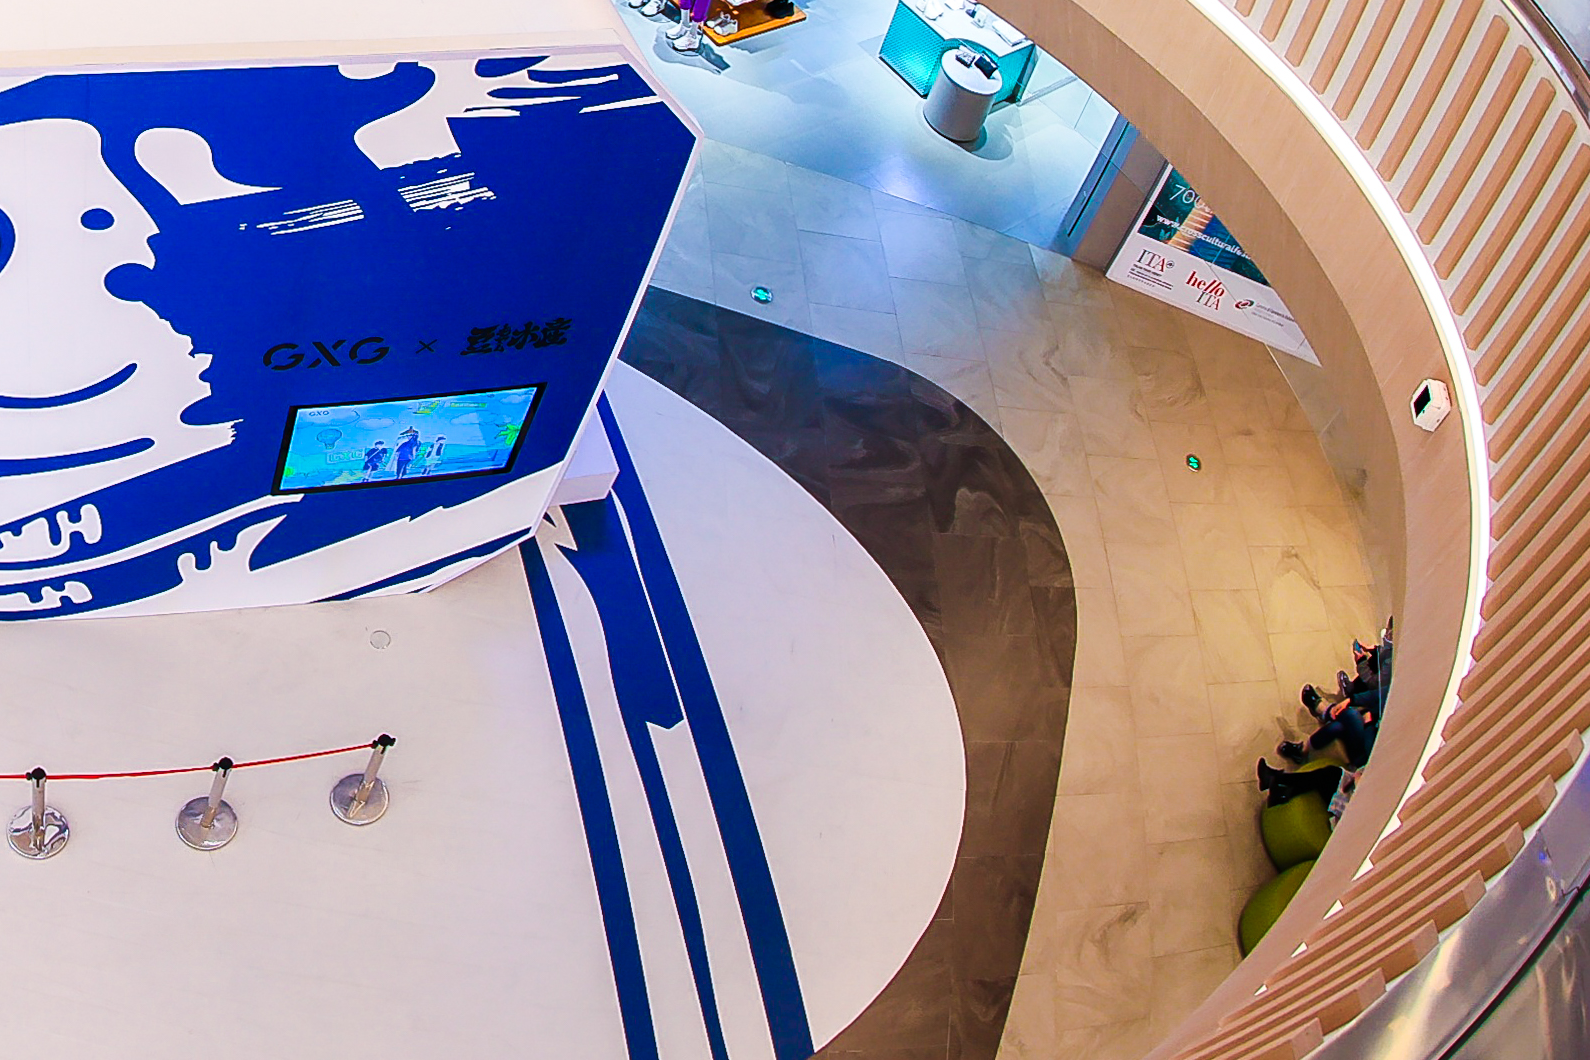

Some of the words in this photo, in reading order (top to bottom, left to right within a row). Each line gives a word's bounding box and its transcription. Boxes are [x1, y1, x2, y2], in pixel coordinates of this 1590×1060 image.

[1136, 248, 1168, 273] ITA
[1185, 269, 1226, 298] hello
[1196, 290, 1221, 311] ITA
[262, 336, 391, 371] GXG
